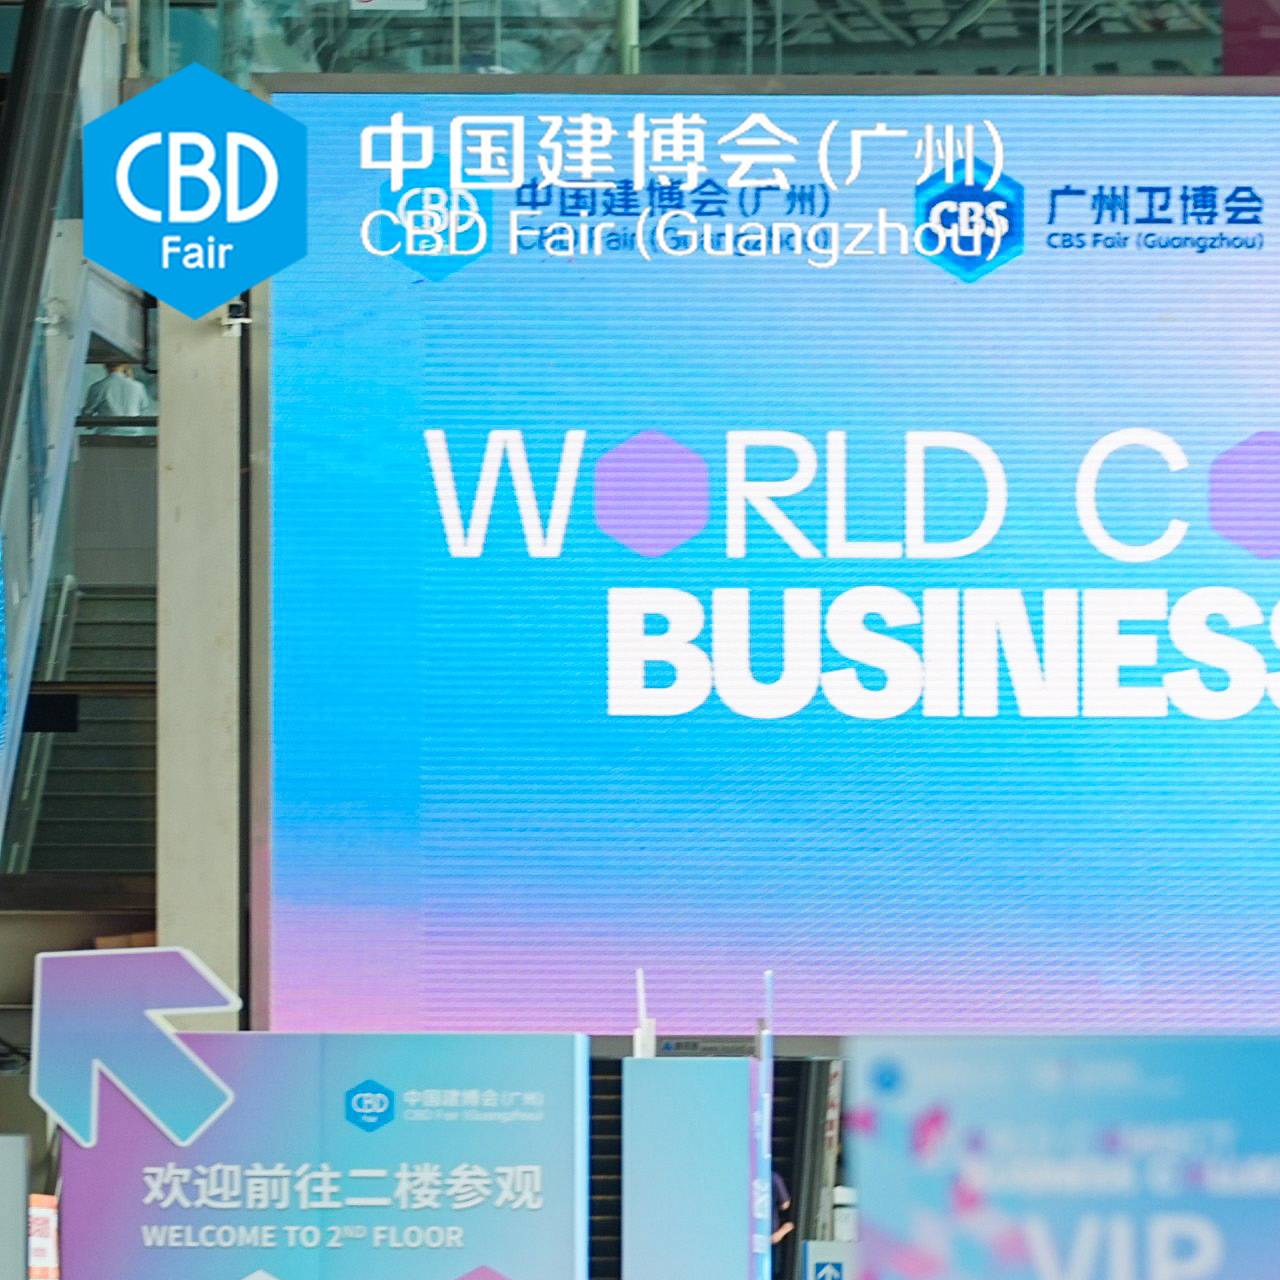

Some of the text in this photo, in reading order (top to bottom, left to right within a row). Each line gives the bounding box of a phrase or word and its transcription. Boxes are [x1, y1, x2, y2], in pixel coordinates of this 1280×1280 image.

[1047, 185, 1264, 225] 广州卫博会
[1046, 232, 1264, 253] CBS Fair (Guangzhou)
[423, 428, 1008, 560] WRLD
[142, 1163, 544, 1210] 欢迎前往二楼参观
[141, 1225, 277, 1248] WELCOME
[283, 1225, 321, 1248] TO
[371, 1225, 465, 1248] FLOOR
